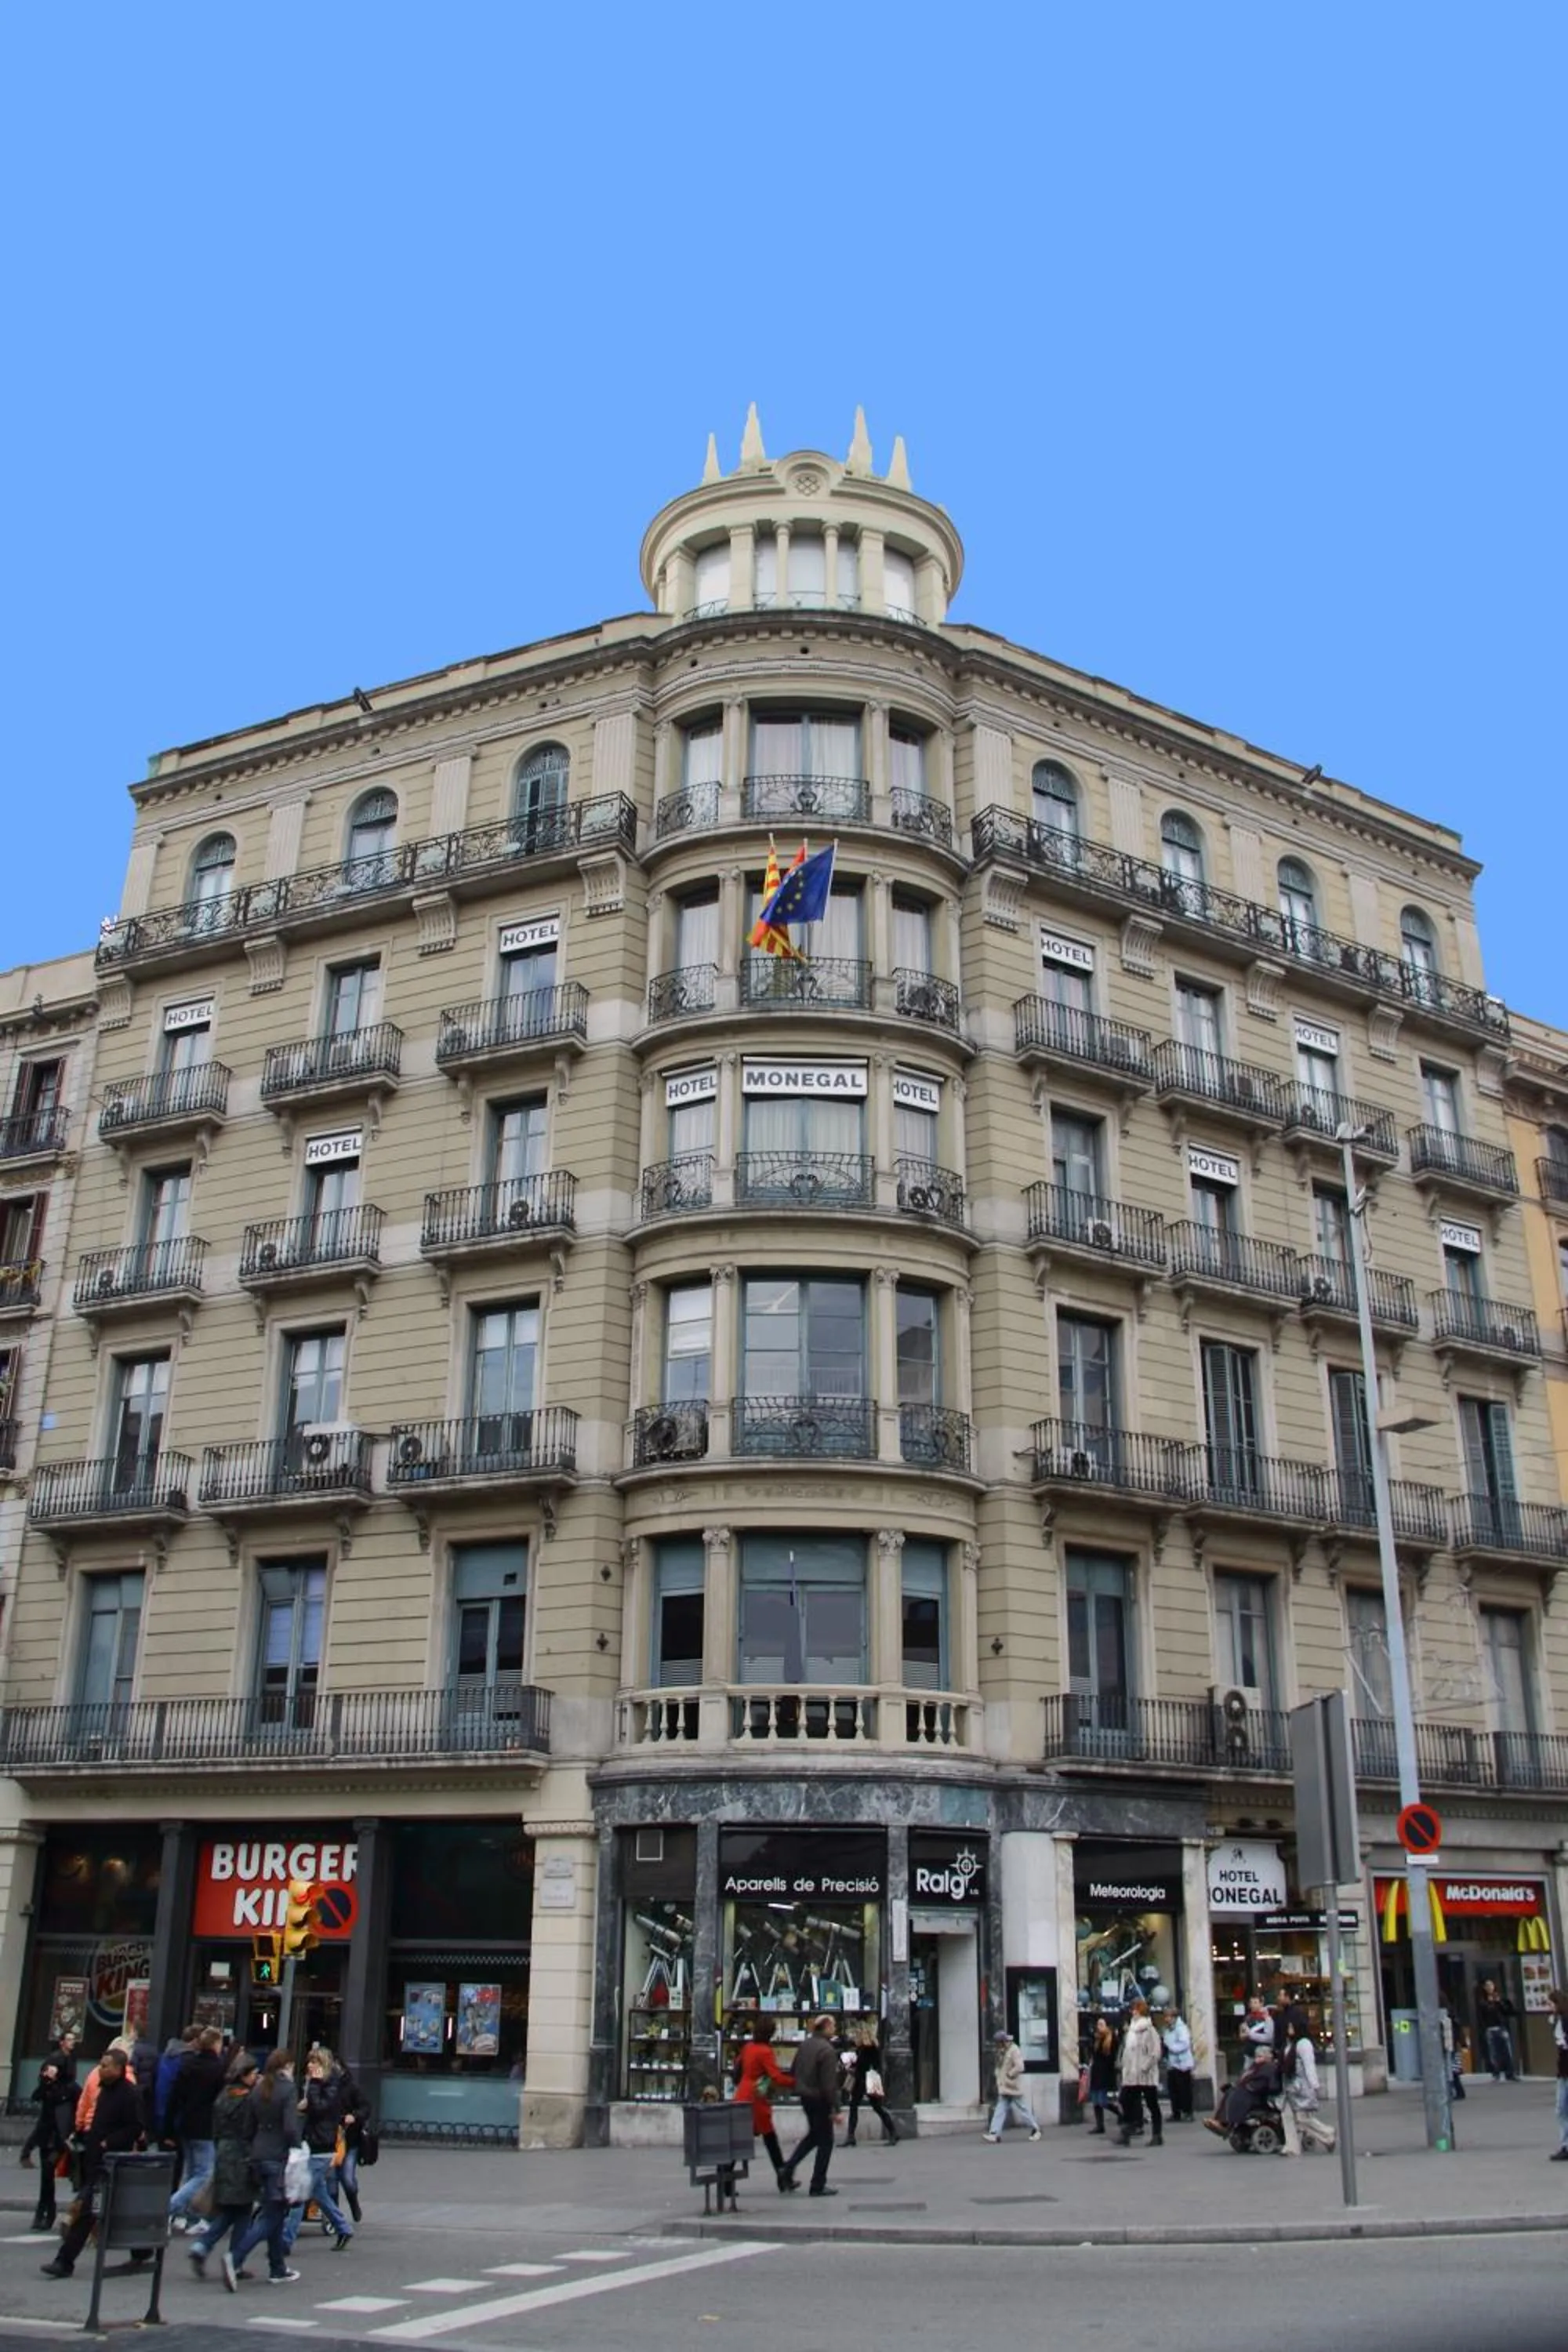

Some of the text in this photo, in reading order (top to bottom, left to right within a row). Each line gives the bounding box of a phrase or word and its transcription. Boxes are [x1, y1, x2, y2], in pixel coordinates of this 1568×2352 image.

[503, 924, 559, 947] HOTEL
[1040, 938, 1091, 965] HOTEL
[167, 1004, 212, 1025] HOTEL
[668, 1075, 717, 1099] HOTEL
[746, 1071, 862, 1088] MONEGAL
[308, 1136, 361, 1158] HOTEL
[1189, 1153, 1236, 1179] HOTEL
[724, 1876, 880, 1893] Aparells de Precisió
[1219, 1870, 1260, 1882] HOTEL
[1208, 1886, 1283, 1905] ONEGAL
[1446, 1884, 1536, 1901] McDonald's
[232, 1888, 289, 1927] KI
